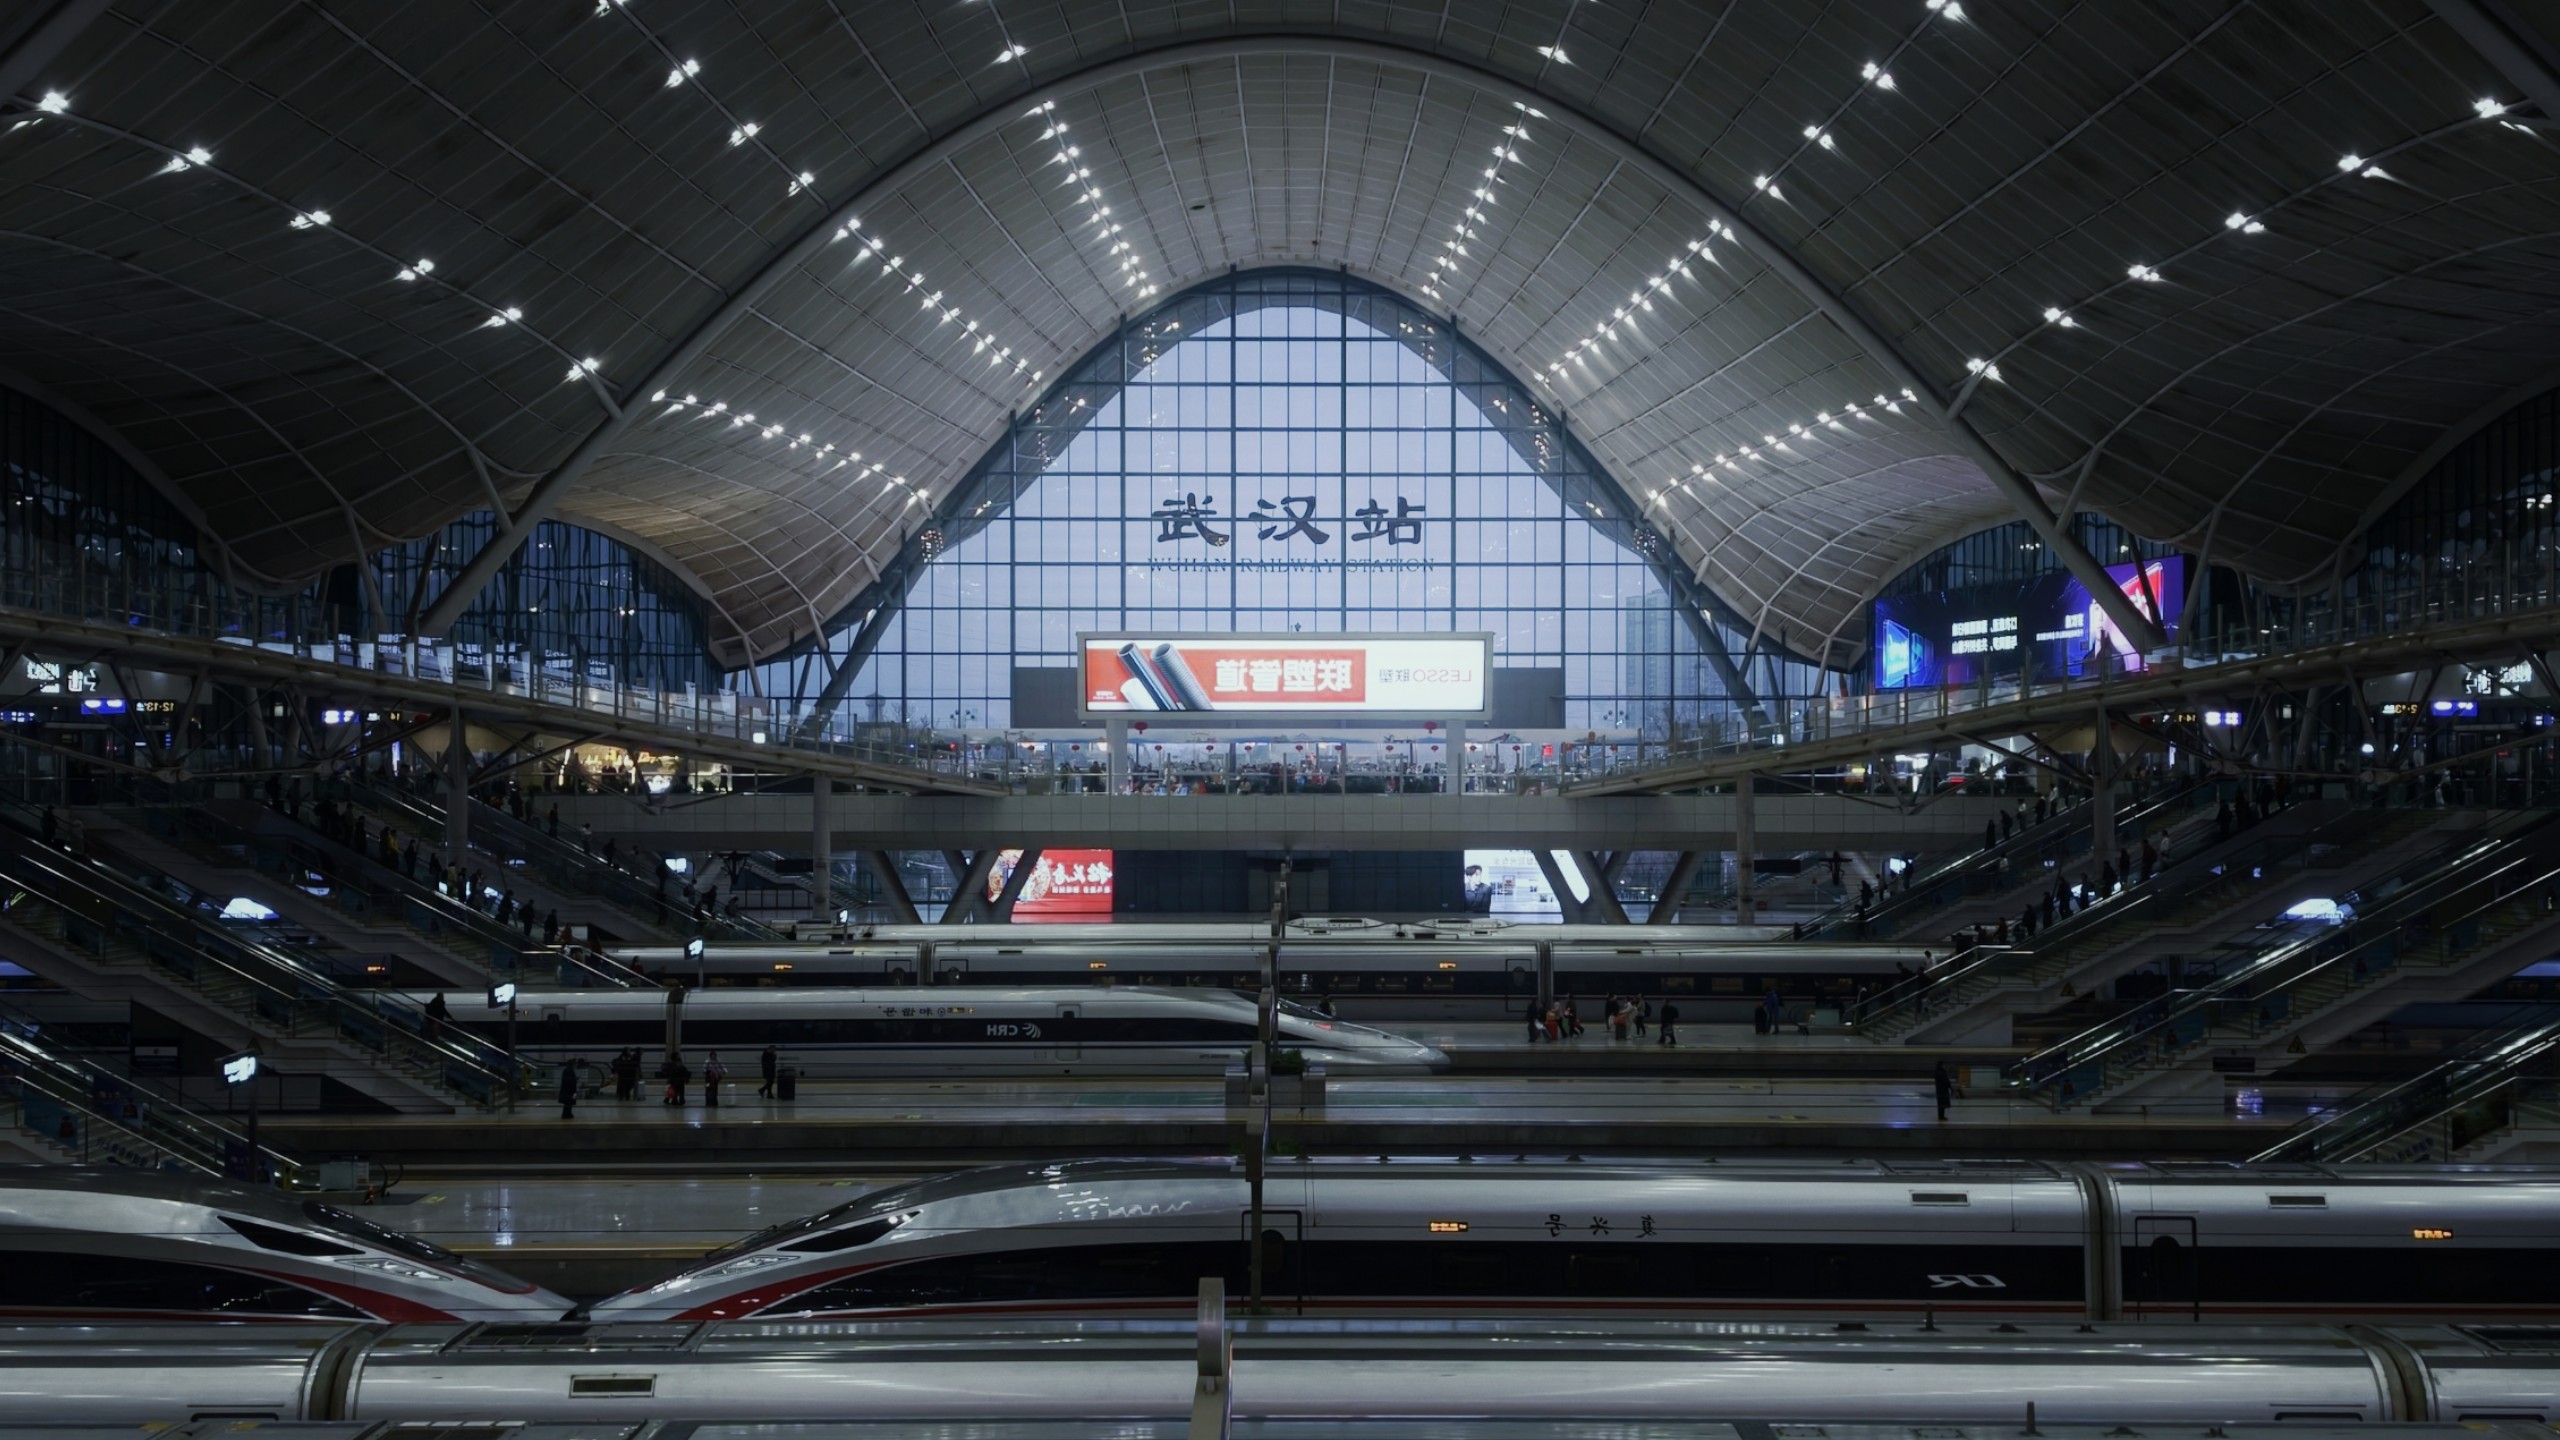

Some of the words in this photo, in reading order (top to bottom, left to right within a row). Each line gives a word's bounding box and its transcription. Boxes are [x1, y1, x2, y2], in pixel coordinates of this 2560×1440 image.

[1152, 493, 1425, 546] 武汉站
[1147, 558, 1227, 572] WUHAN
[1240, 558, 1337, 572] RAILWAY
[1347, 558, 1435, 572] STATION
